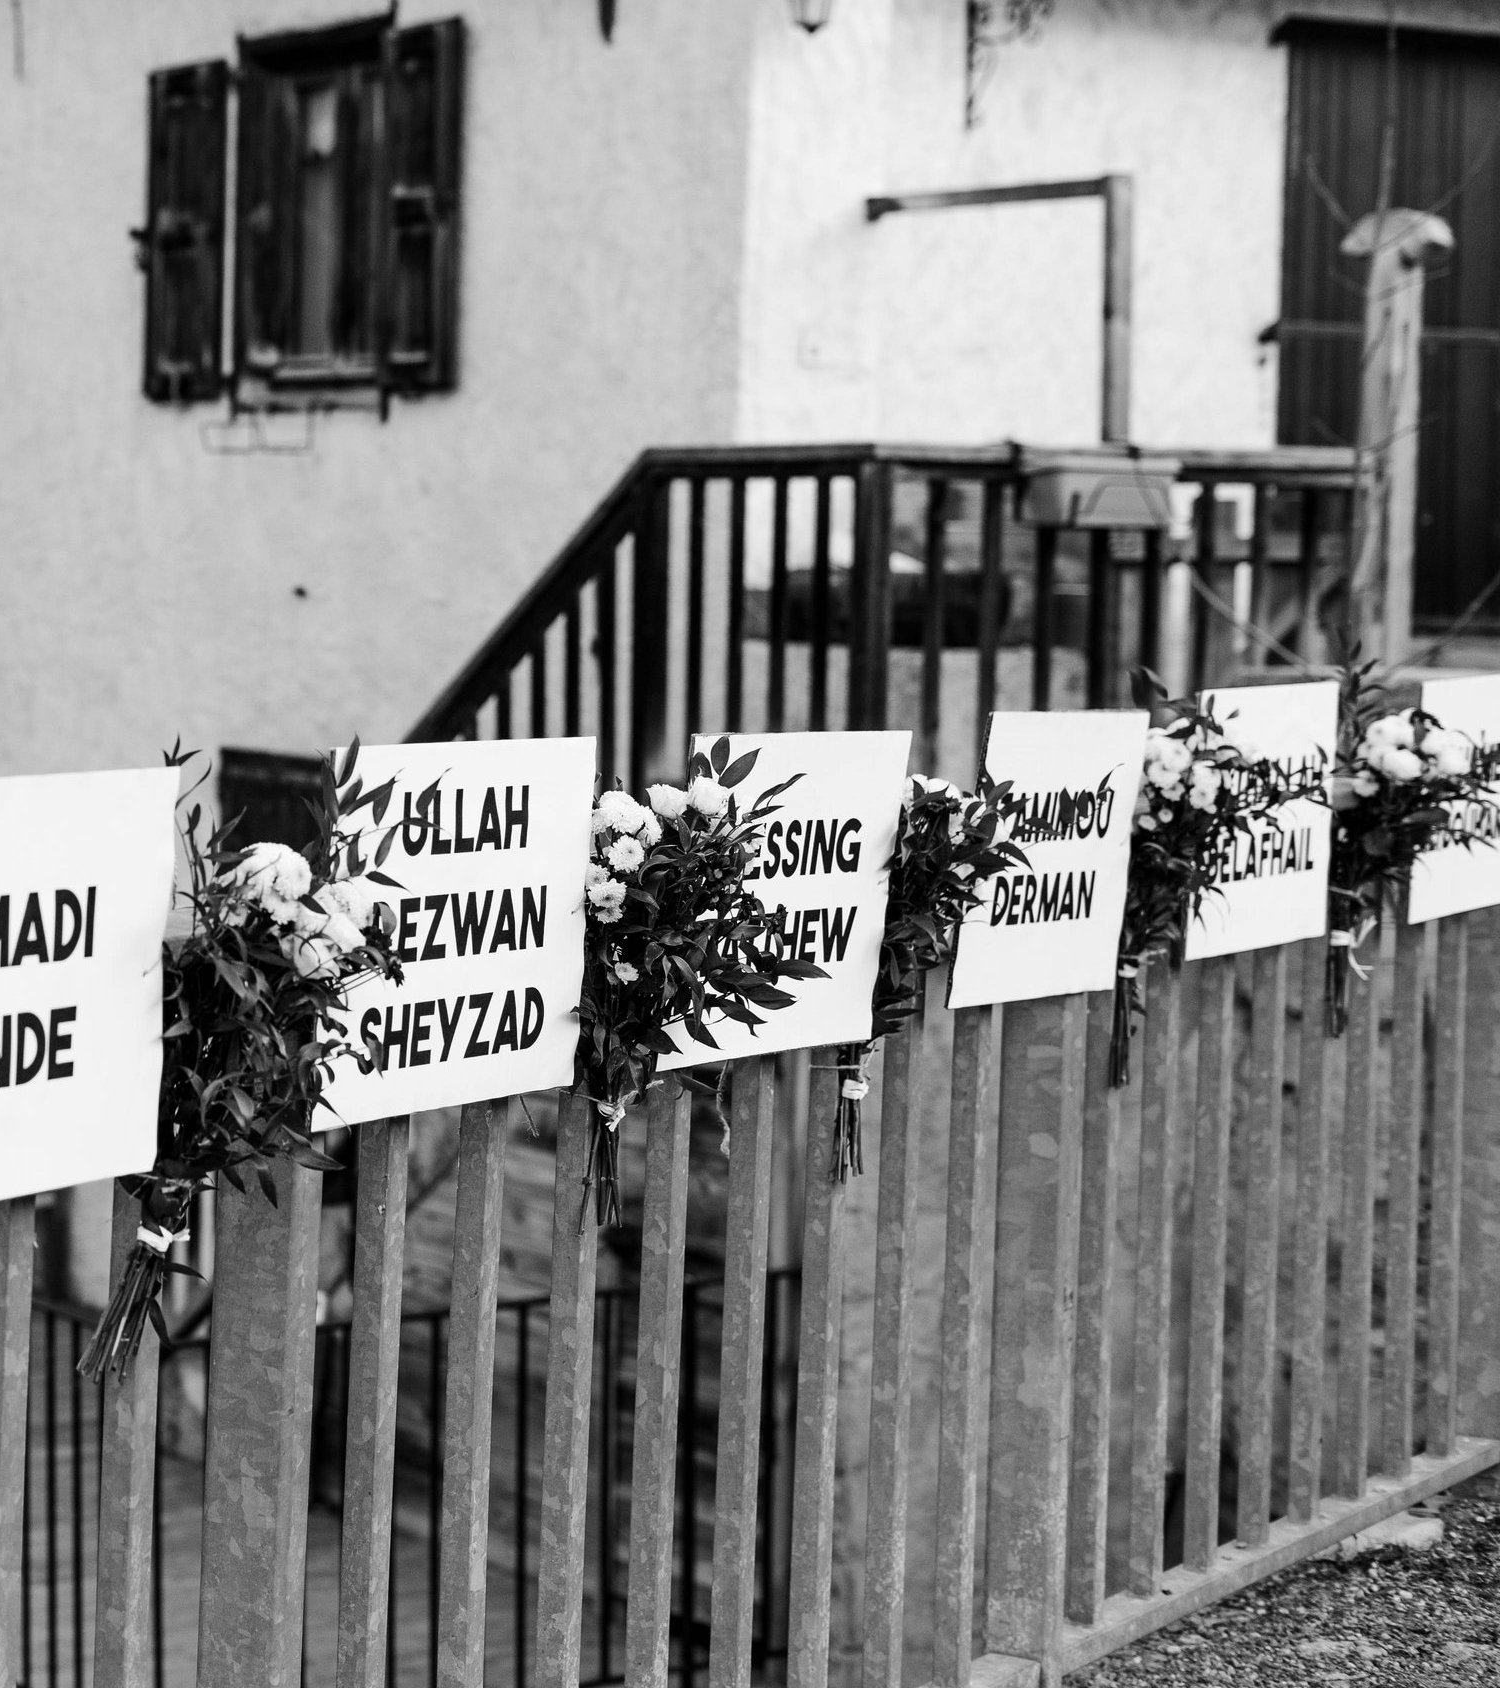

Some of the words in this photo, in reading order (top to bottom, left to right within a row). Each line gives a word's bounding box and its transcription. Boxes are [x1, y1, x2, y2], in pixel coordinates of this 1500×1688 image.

[402, 785, 530, 857] ULLAH
[399, 885, 548, 964] EZWAN
[990, 870, 1096, 927] DERMAN
[358, 986, 545, 1075] SHEYZAD
